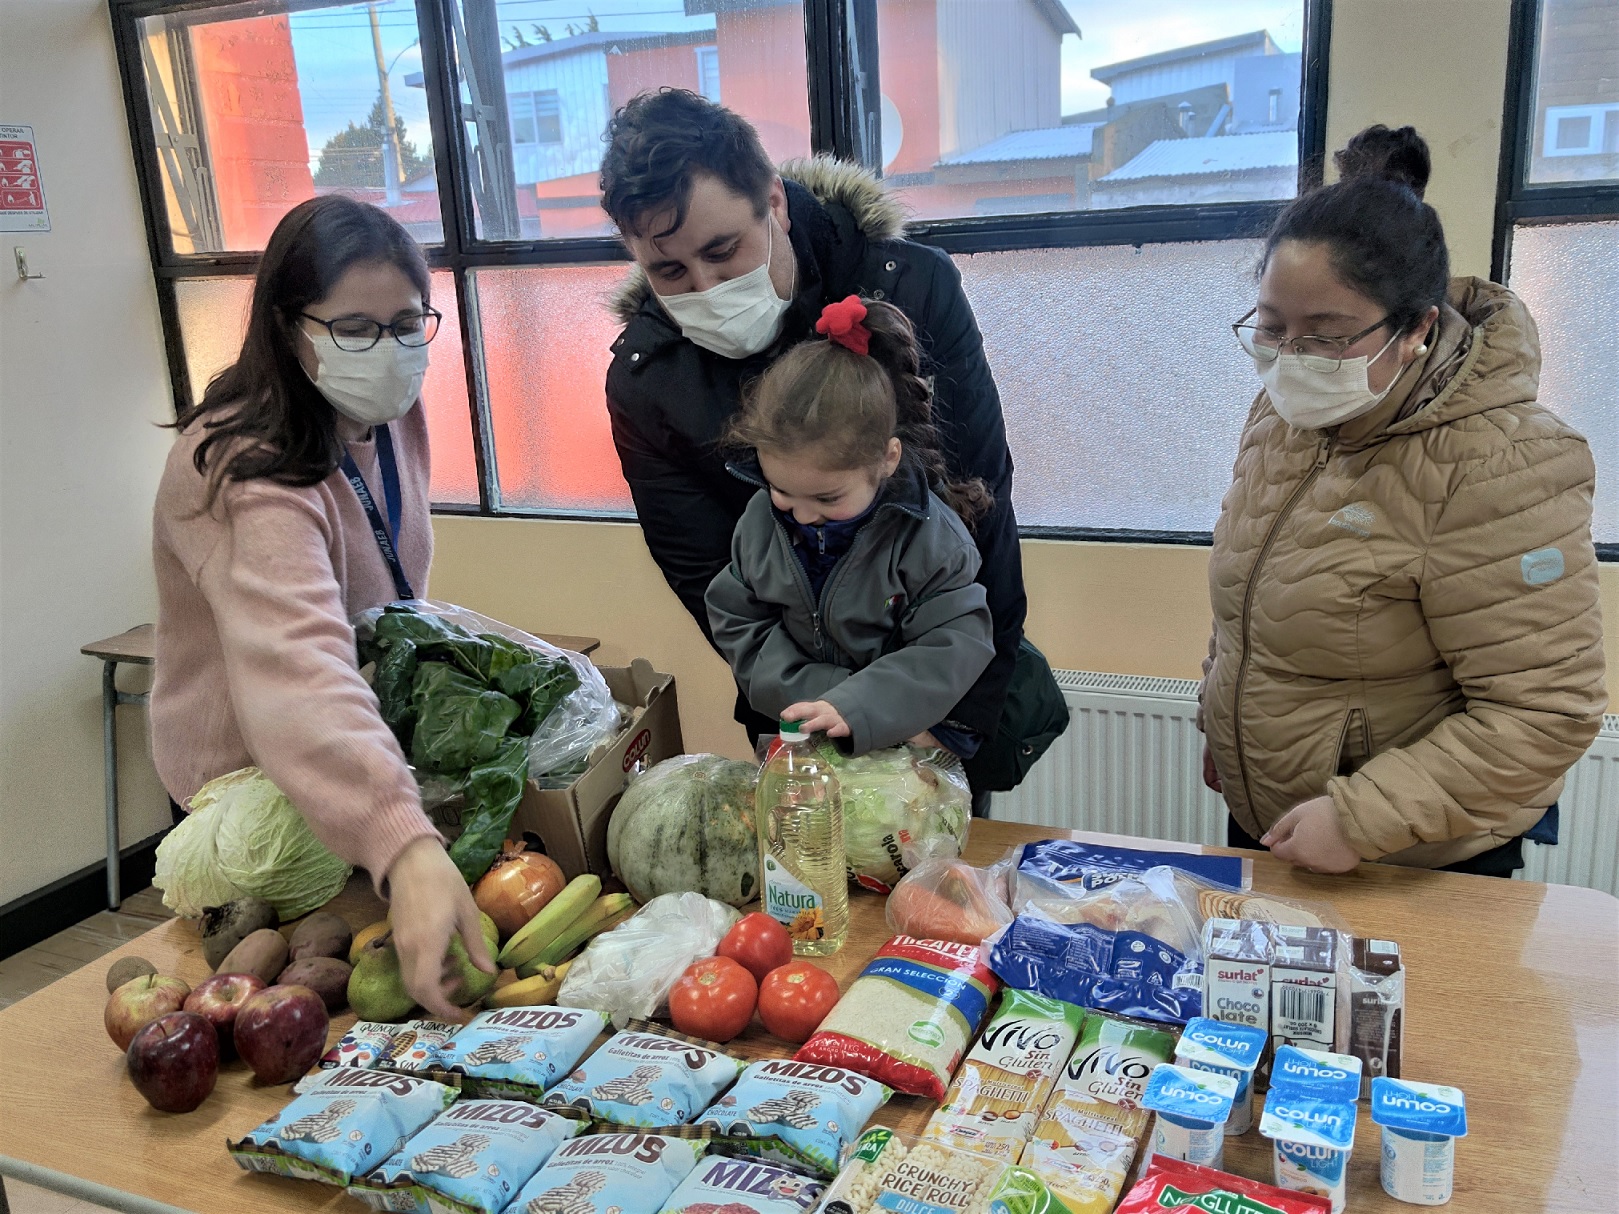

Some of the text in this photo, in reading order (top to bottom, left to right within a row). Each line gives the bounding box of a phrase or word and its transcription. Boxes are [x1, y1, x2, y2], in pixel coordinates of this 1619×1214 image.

[350, 476, 374, 512] JUNAEB
[375, 529, 396, 563] JUNAEB
[769, 884, 816, 909] Natura
[869, 966, 902, 974] GRAN
[1217, 969, 1258, 982] surlat
[1217, 998, 1260, 1013] Choco
[485, 1010, 584, 1030] MIZOS
[1220, 1010, 1258, 1024] late
[1192, 1032, 1250, 1051] COLUN
[608, 1048, 641, 1058] Galletitas
[617, 1035, 717, 1070] MIZOS
[1025, 1050, 1050, 1060] Sin
[999, 1056, 1053, 1070] Gluten
[1284, 1062, 1347, 1080] COLUN
[324, 1068, 425, 1096] MIZOS
[753, 1075, 790, 1084] Galletitas
[761, 1061, 868, 1096] MIZOS
[1114, 1077, 1142, 1091] Sin
[953, 1077, 1030, 1102] SPAGHETTI
[1088, 1081, 1144, 1101] Gluten
[1160, 1085, 1223, 1105] COLUN
[706, 1109, 738, 1117] CHOCOLATE
[1383, 1095, 1451, 1114] COLUN
[447, 1104, 555, 1129] MIZOS
[1044, 1109, 1123, 1136] SPAGHETTI
[1274, 1106, 1341, 1125] COLUN
[559, 1134, 667, 1164] MIZOS
[1280, 1140, 1338, 1159] COLUN
[1310, 1160, 1338, 1169] LIGHT
[896, 1162, 973, 1192] CRUNCHY
[881, 1173, 970, 1208] RICE ROLL
[896, 1200, 936, 1214] DULCE
